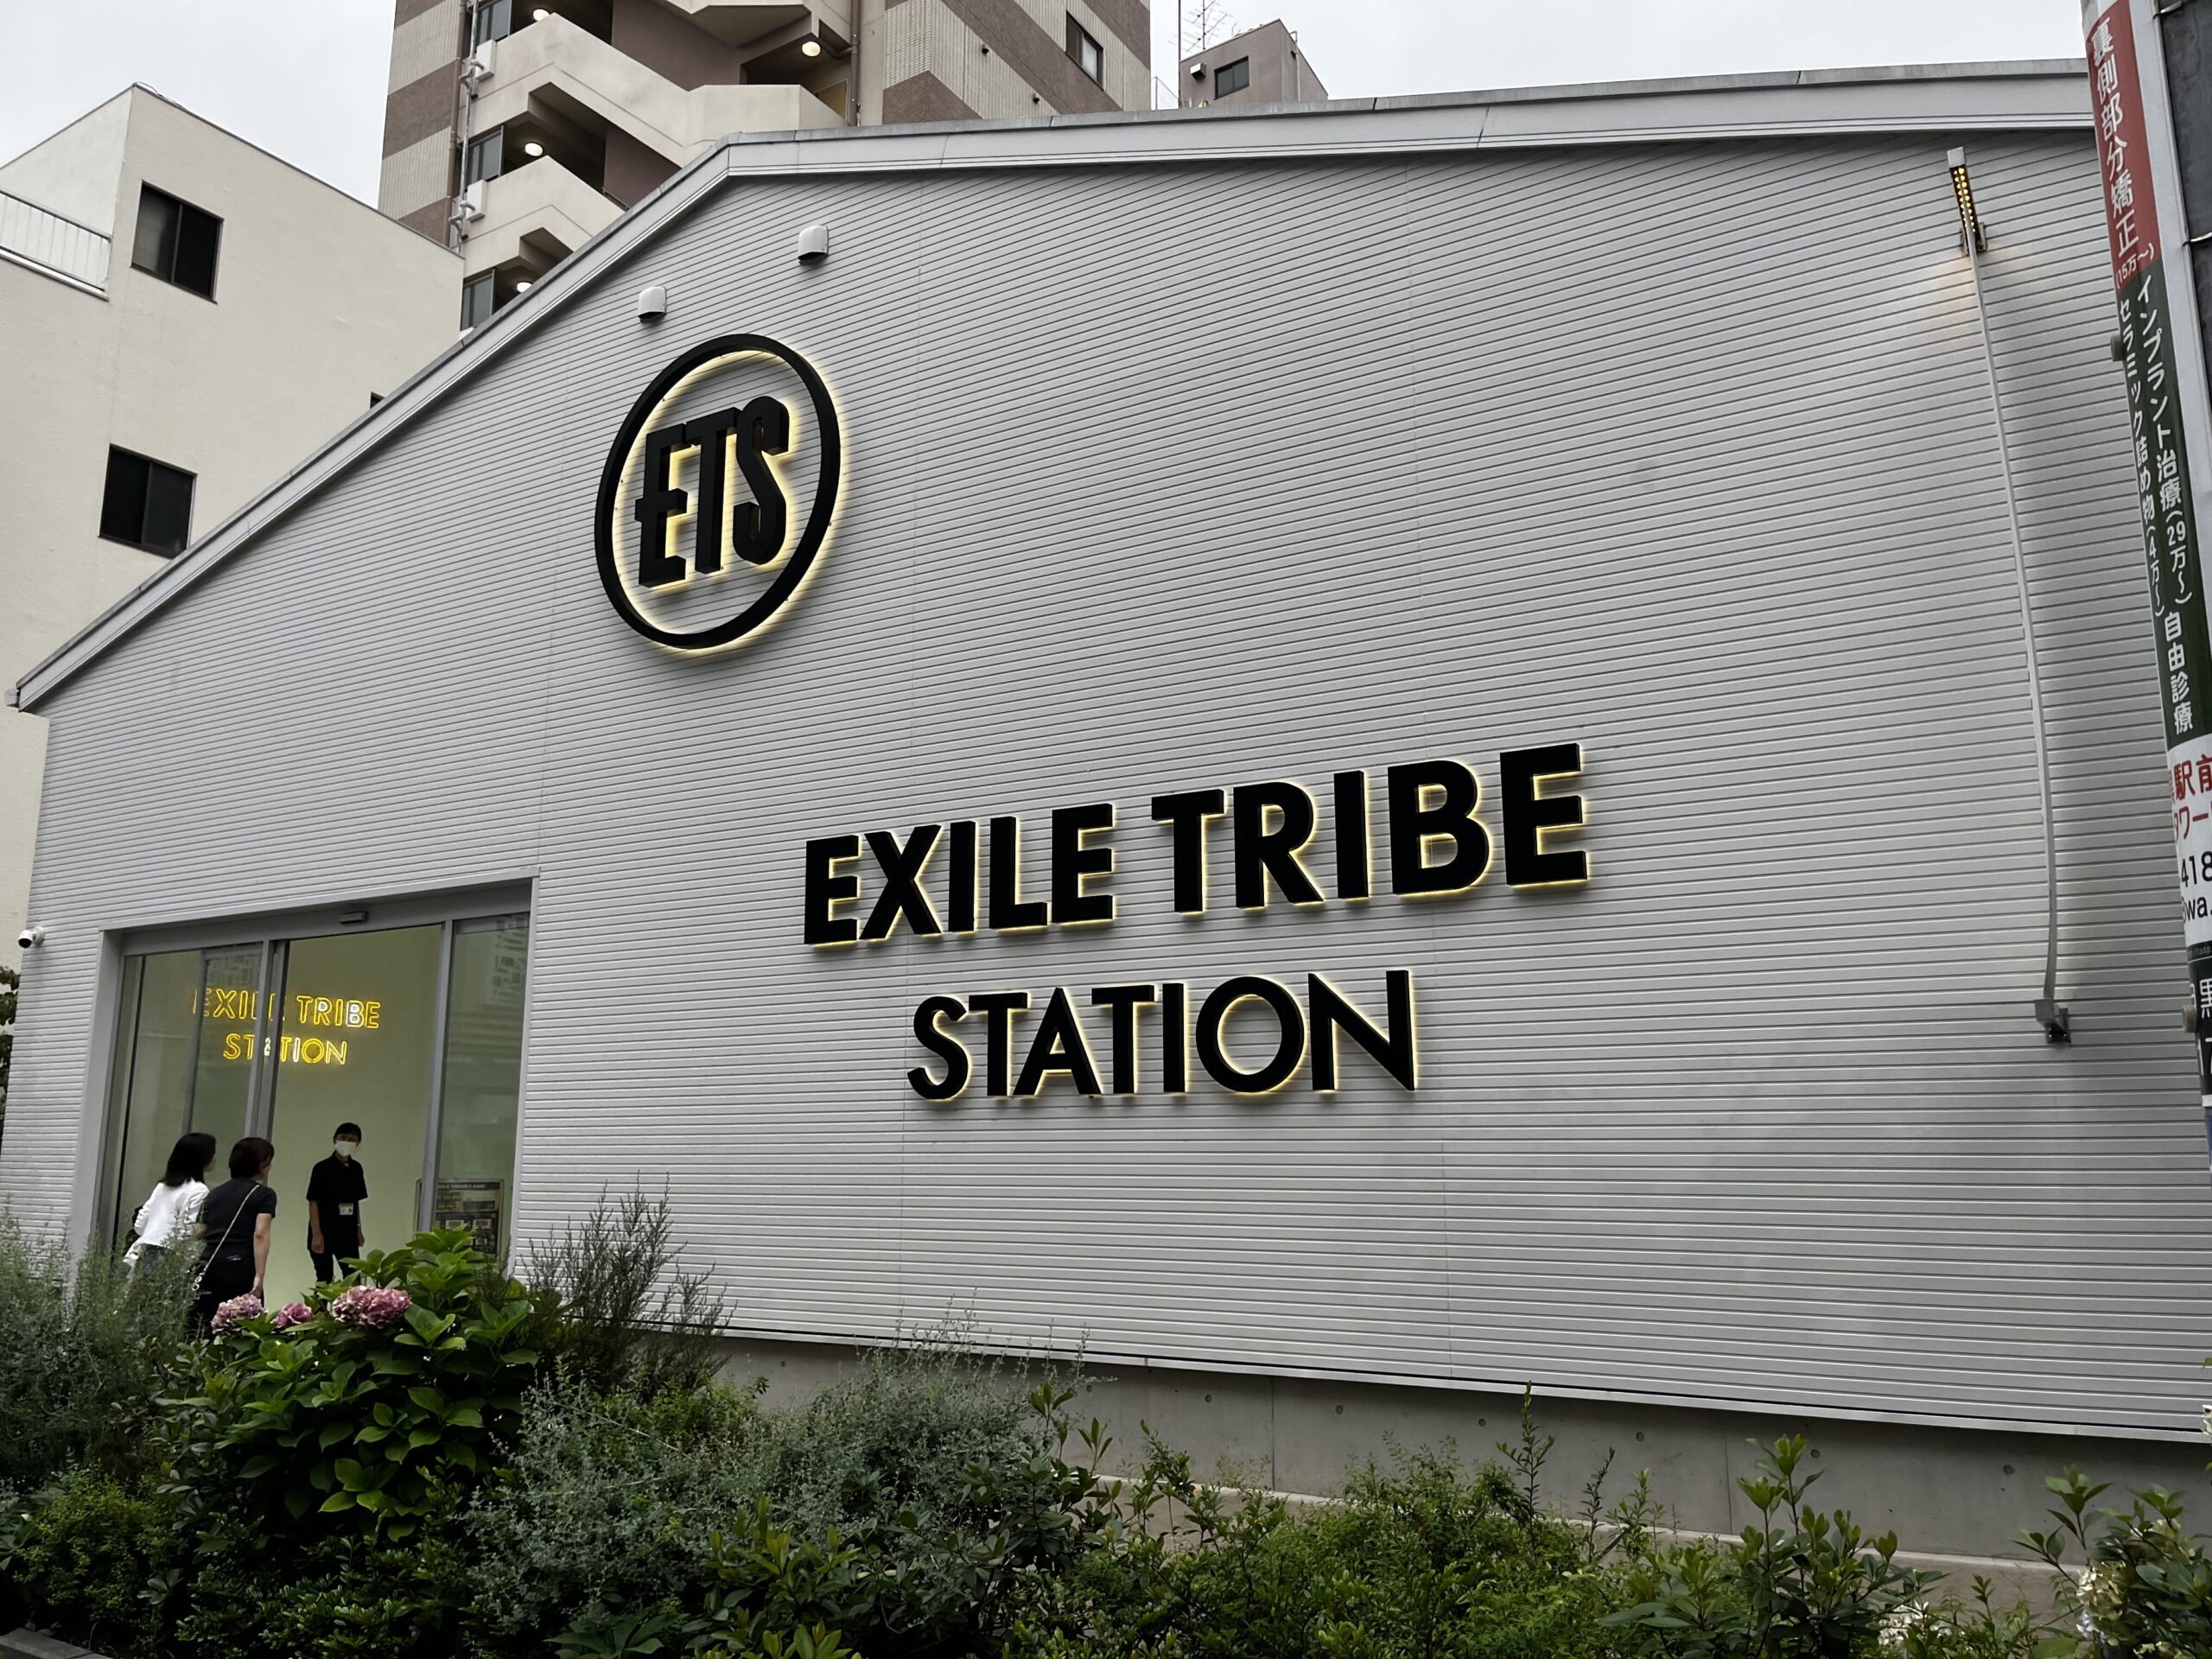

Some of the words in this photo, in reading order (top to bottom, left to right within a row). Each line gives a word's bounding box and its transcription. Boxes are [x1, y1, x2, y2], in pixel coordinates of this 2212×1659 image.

[2091, 17, 2139, 258] 裏側部分矯正
[635, 396, 790, 588] ETS
[2164, 612, 2193, 734] 自由診療
[2170, 753, 2212, 801] 駅前
[804, 803, 1115, 945] EXILE
[1151, 743, 1588, 913] TRIBE
[296, 995, 381, 1029] TRIBE
[907, 969, 1418, 1101] STATION
